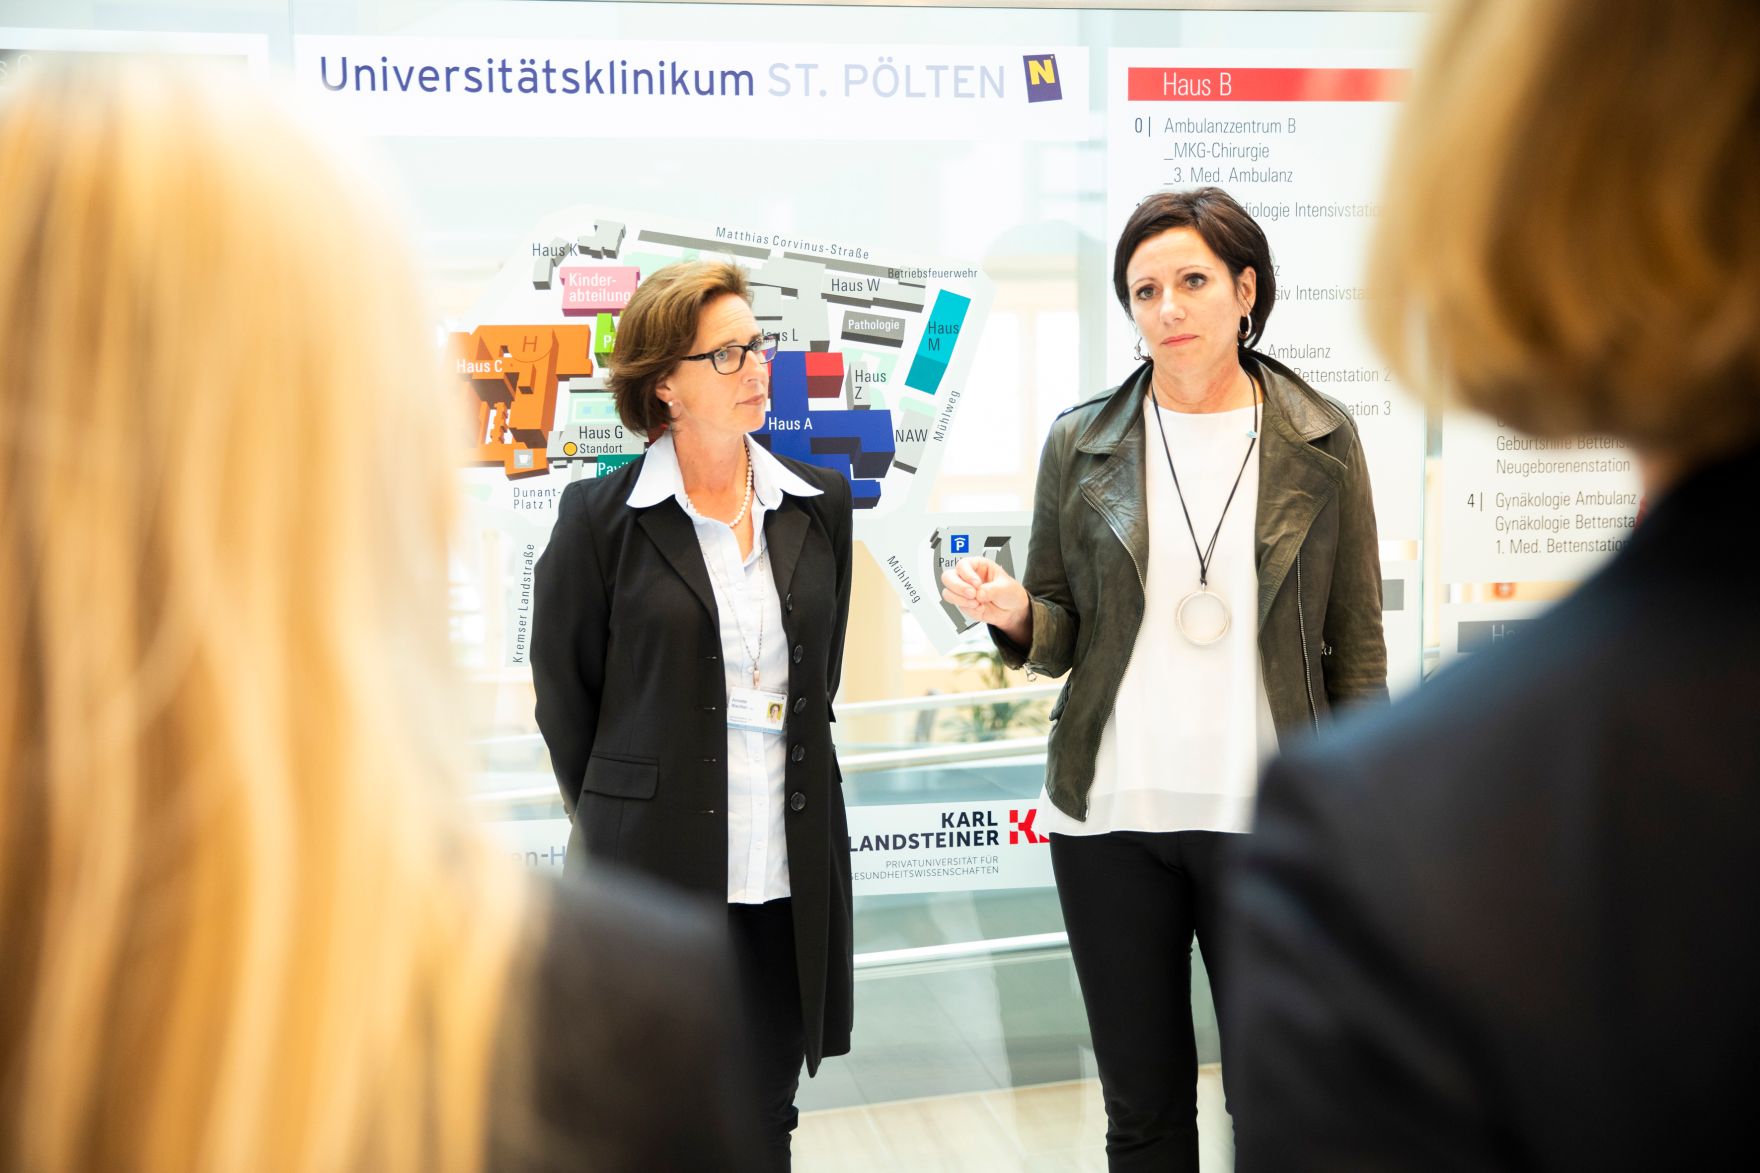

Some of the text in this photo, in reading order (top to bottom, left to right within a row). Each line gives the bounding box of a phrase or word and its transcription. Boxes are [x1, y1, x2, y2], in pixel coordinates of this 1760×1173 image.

[321, 56, 1005, 98] Universitätsklinikum ST. PÖLTEN
[1163, 72, 1232, 97] Haus B
[1164, 117, 1282, 134] Ambulanzzentrum
[1288, 117, 1297, 134] B
[1190, 167, 1223, 183] Med.
[1229, 167, 1293, 183] Ambulanz
[532, 243, 578, 257] Haus K
[716, 226, 869, 260] Matthias Corvinus-Straße
[569, 273, 617, 287] Kinder-
[888, 268, 978, 280] Betriebsfeuerwehr
[831, 279, 881, 292] Haus W
[569, 289, 632, 305] abteilung
[848, 319, 900, 332] Pathologie
[928, 321, 960, 334] Haus
[792, 328, 799, 342] L
[928, 339, 941, 351] M
[1268, 344, 1331, 359] Ambulanz
[456, 359, 503, 373] Haus C
[855, 370, 886, 383] Haus
[1384, 367, 1392, 383] 2
[855, 386, 862, 400] Z
[1384, 400, 1391, 416] 3
[933, 390, 960, 442] Mühlweg
[768, 417, 813, 431] Haus A
[579, 425, 623, 440] Haus G
[895, 429, 928, 443] NAW
[580, 443, 623, 454] Standort
[1496, 458, 1631, 478] Neugeborenenstation
[513, 487, 561, 498] Dunant-
[513, 499, 553, 510] Platz 1
[1495, 492, 1571, 511] Gynäkologie
[1576, 490, 1637, 506] Ambulanz
[1495, 514, 1636, 534] Gynäkologie Bettensta
[1496, 540, 1505, 555] 1.
[1510, 539, 1542, 555] Med.
[887, 555, 921, 604] Mühlweg
[512, 543, 535, 664] Kremser Landstraße
[941, 811, 998, 828] KARL
[848, 830, 1000, 852] LANDSTEINER
[885, 855, 999, 868] PRIVATUNIVERSITÄT FÜR
[851, 866, 999, 881] ESUNDHEITSWISSENSCHAFTEN
